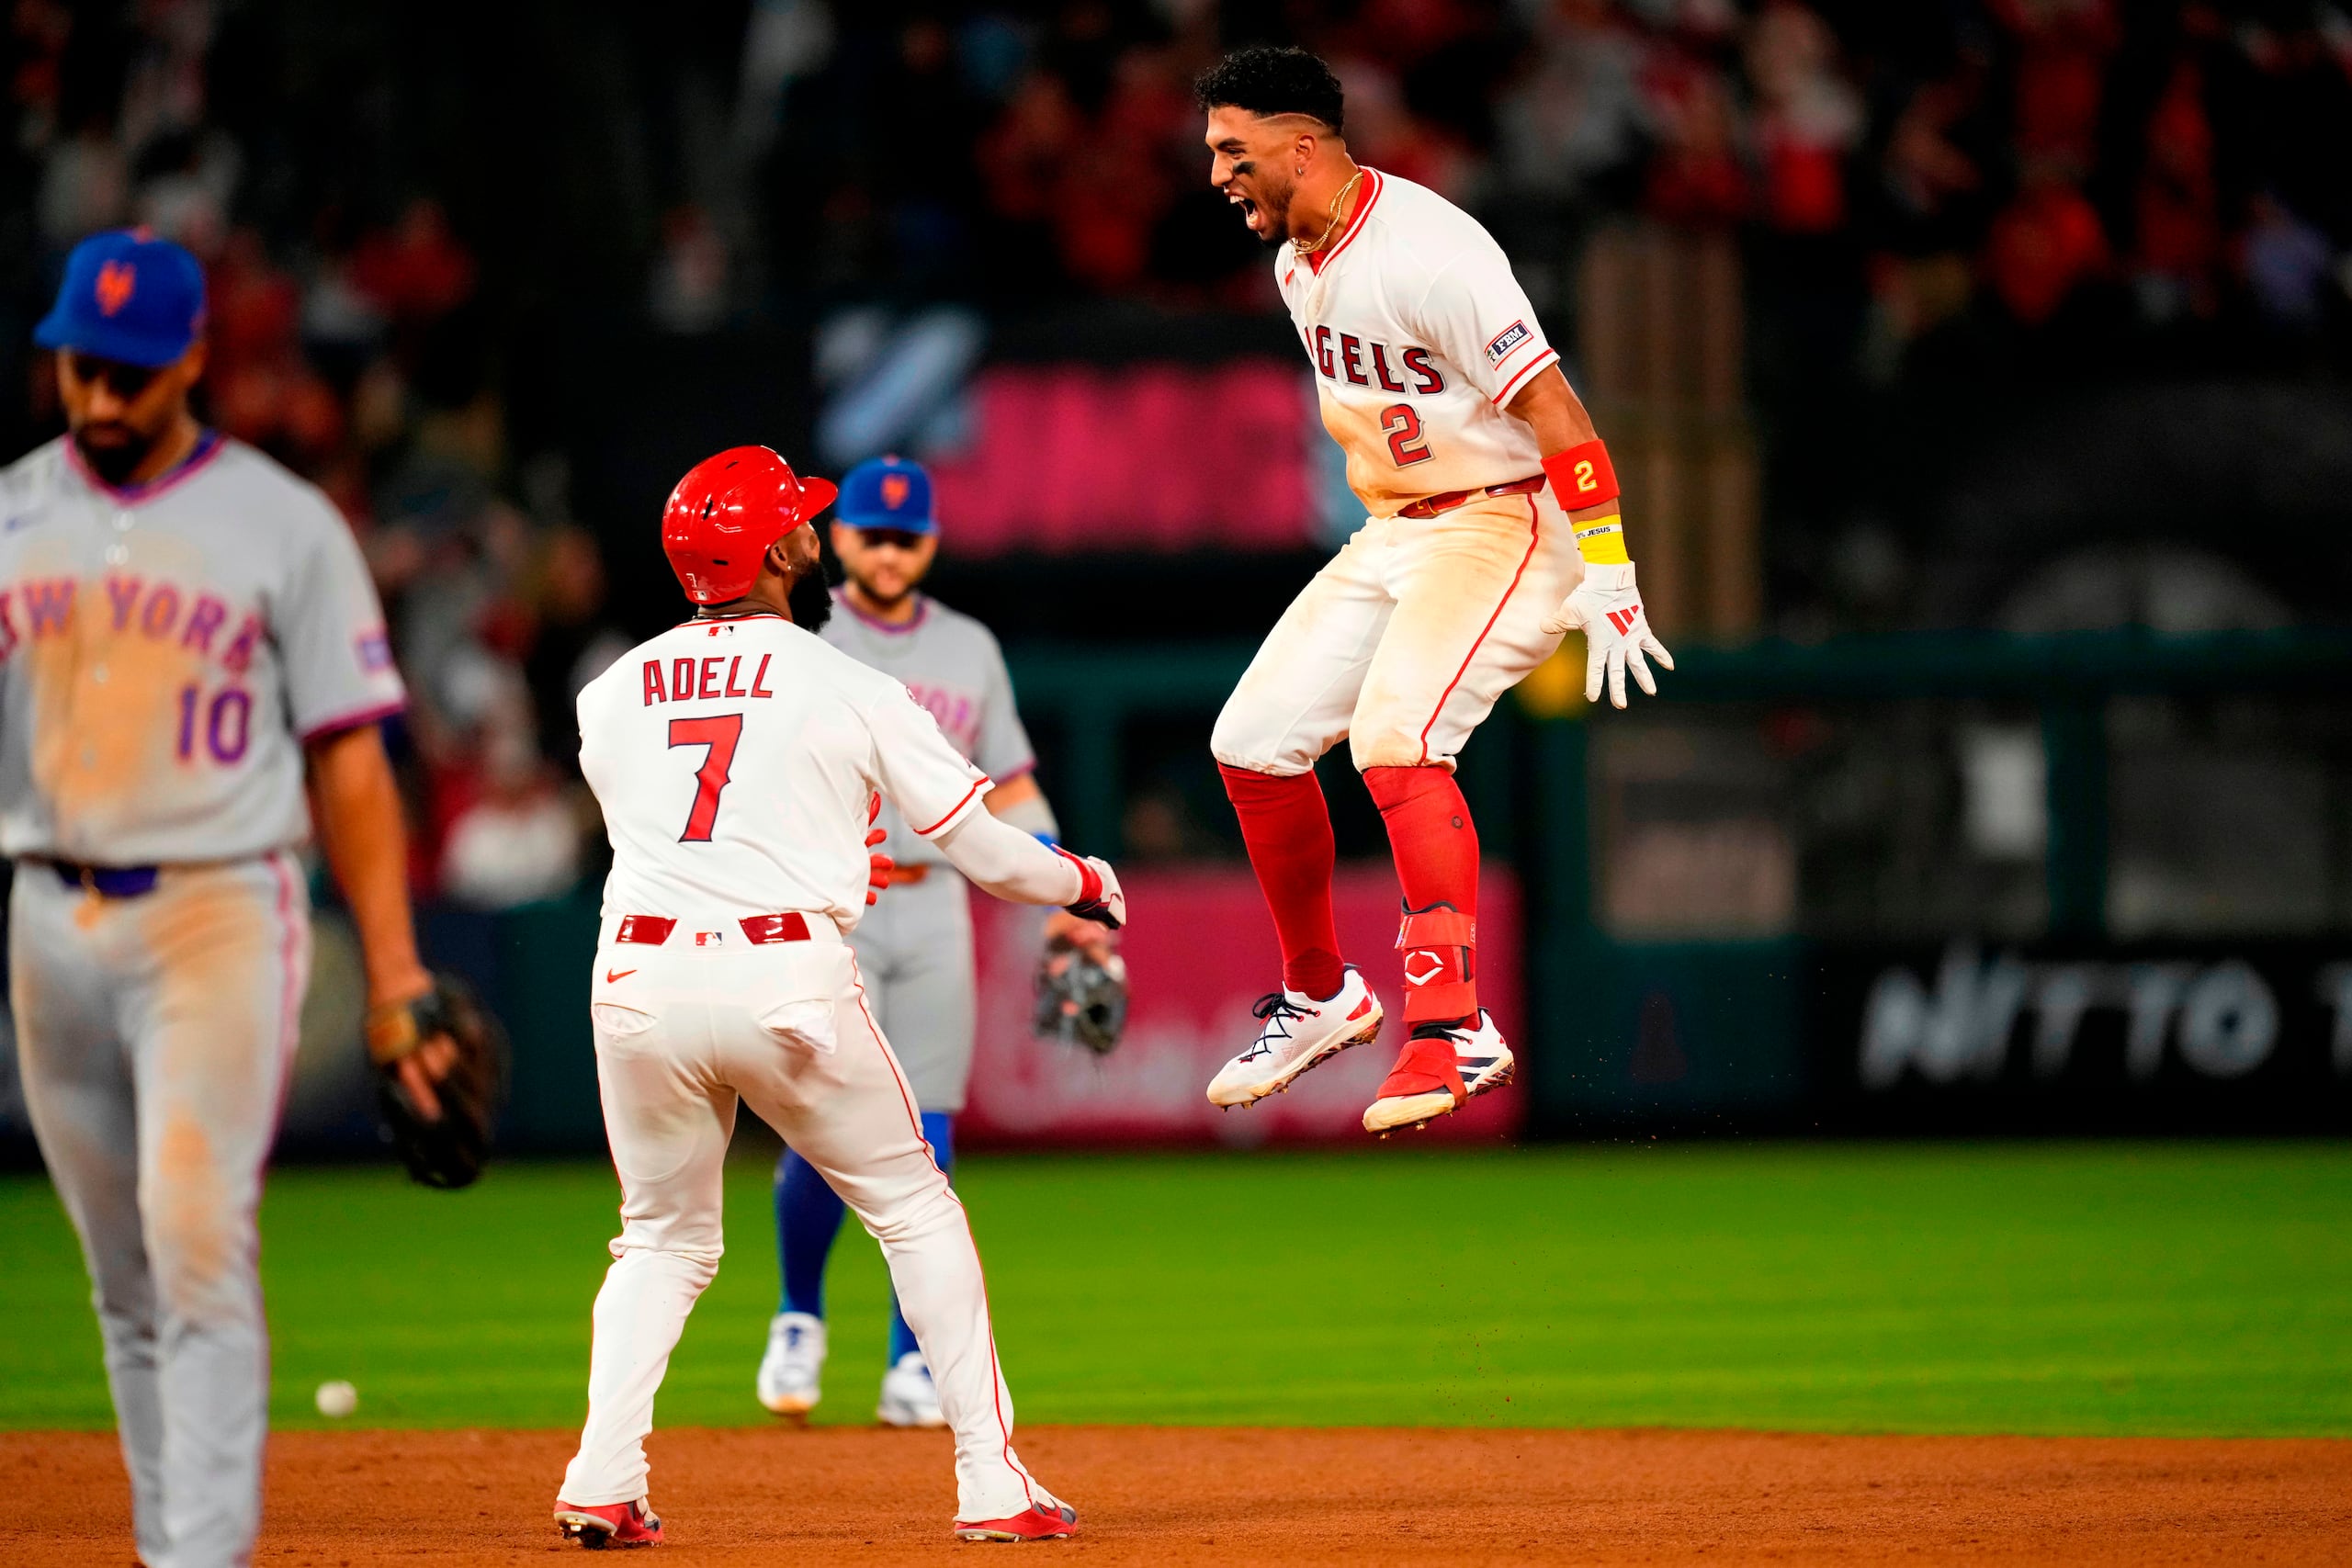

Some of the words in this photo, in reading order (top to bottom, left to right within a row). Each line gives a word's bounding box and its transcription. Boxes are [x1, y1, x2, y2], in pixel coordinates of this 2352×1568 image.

[1305, 324, 1446, 395] GELS
[1494, 325, 1525, 353] FBM
[1380, 402, 1435, 468] 2
[1574, 459, 1599, 492] 2
[1587, 525, 1611, 536] JESUS
[643, 653, 774, 707] ADELL
[177, 682, 253, 767] 10
[668, 712, 744, 843] 7
